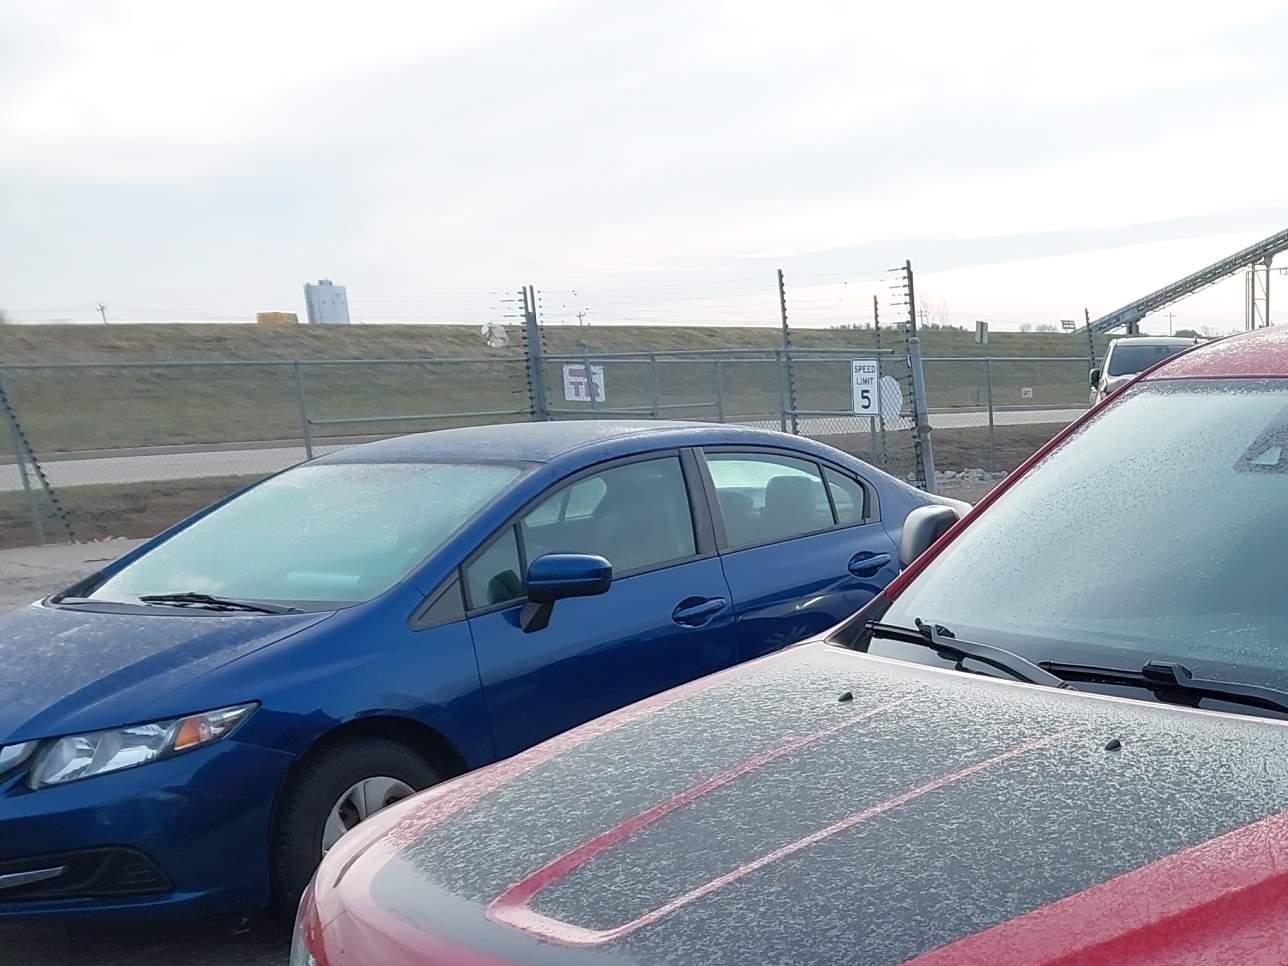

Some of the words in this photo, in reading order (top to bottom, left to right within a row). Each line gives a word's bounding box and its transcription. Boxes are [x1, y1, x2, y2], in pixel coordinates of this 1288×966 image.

[854, 364, 876, 374] SPEED
[856, 376, 874, 386] LIMIT
[860, 389, 871, 409] 5
